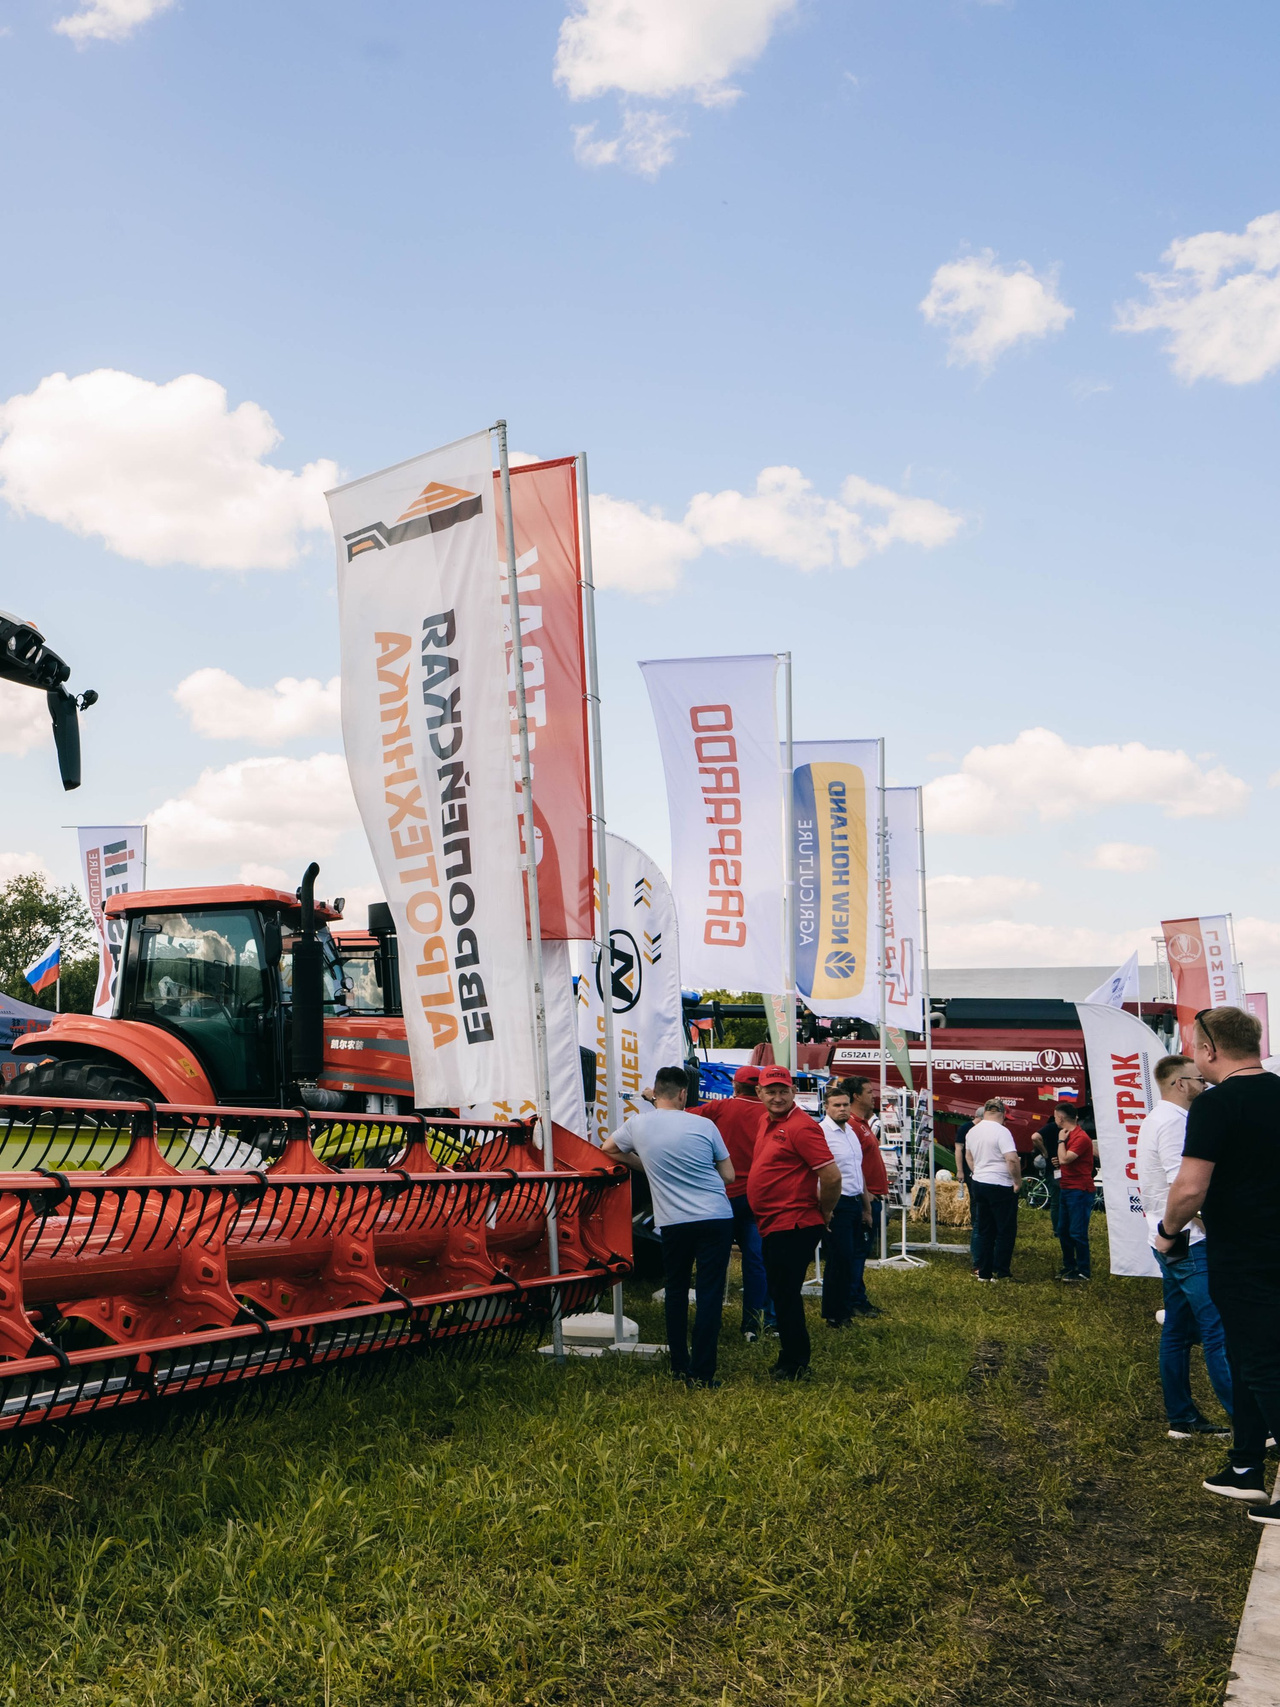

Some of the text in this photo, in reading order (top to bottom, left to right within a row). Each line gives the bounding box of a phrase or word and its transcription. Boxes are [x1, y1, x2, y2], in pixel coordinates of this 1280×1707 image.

[841, 1051, 871, 1059] GS12A1
[934, 1060, 1033, 1072] GOMSELMASH
[622, 1029, 643, 1122] УЩЕЕ!
